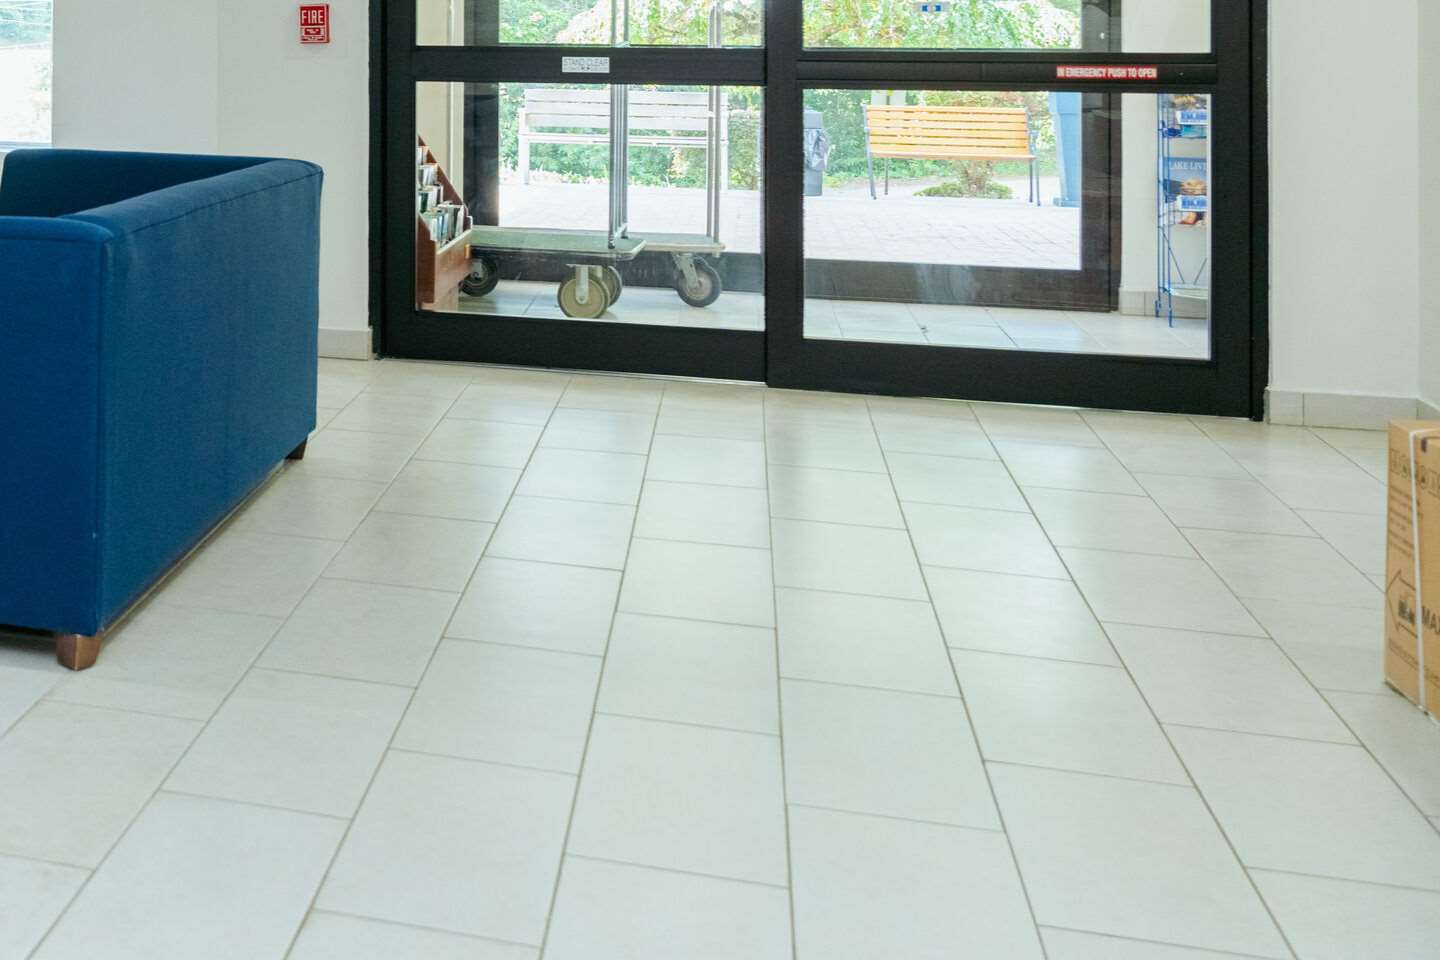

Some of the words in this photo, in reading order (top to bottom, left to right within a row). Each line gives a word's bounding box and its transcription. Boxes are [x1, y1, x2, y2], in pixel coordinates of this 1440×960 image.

[301, 10, 324, 24] FIRE
[1066, 67, 1106, 77] EMERGENCY
[1107, 67, 1127, 78] PUSH
[1127, 67, 1137, 78] TO
[1137, 67, 1157, 78] OPEN
